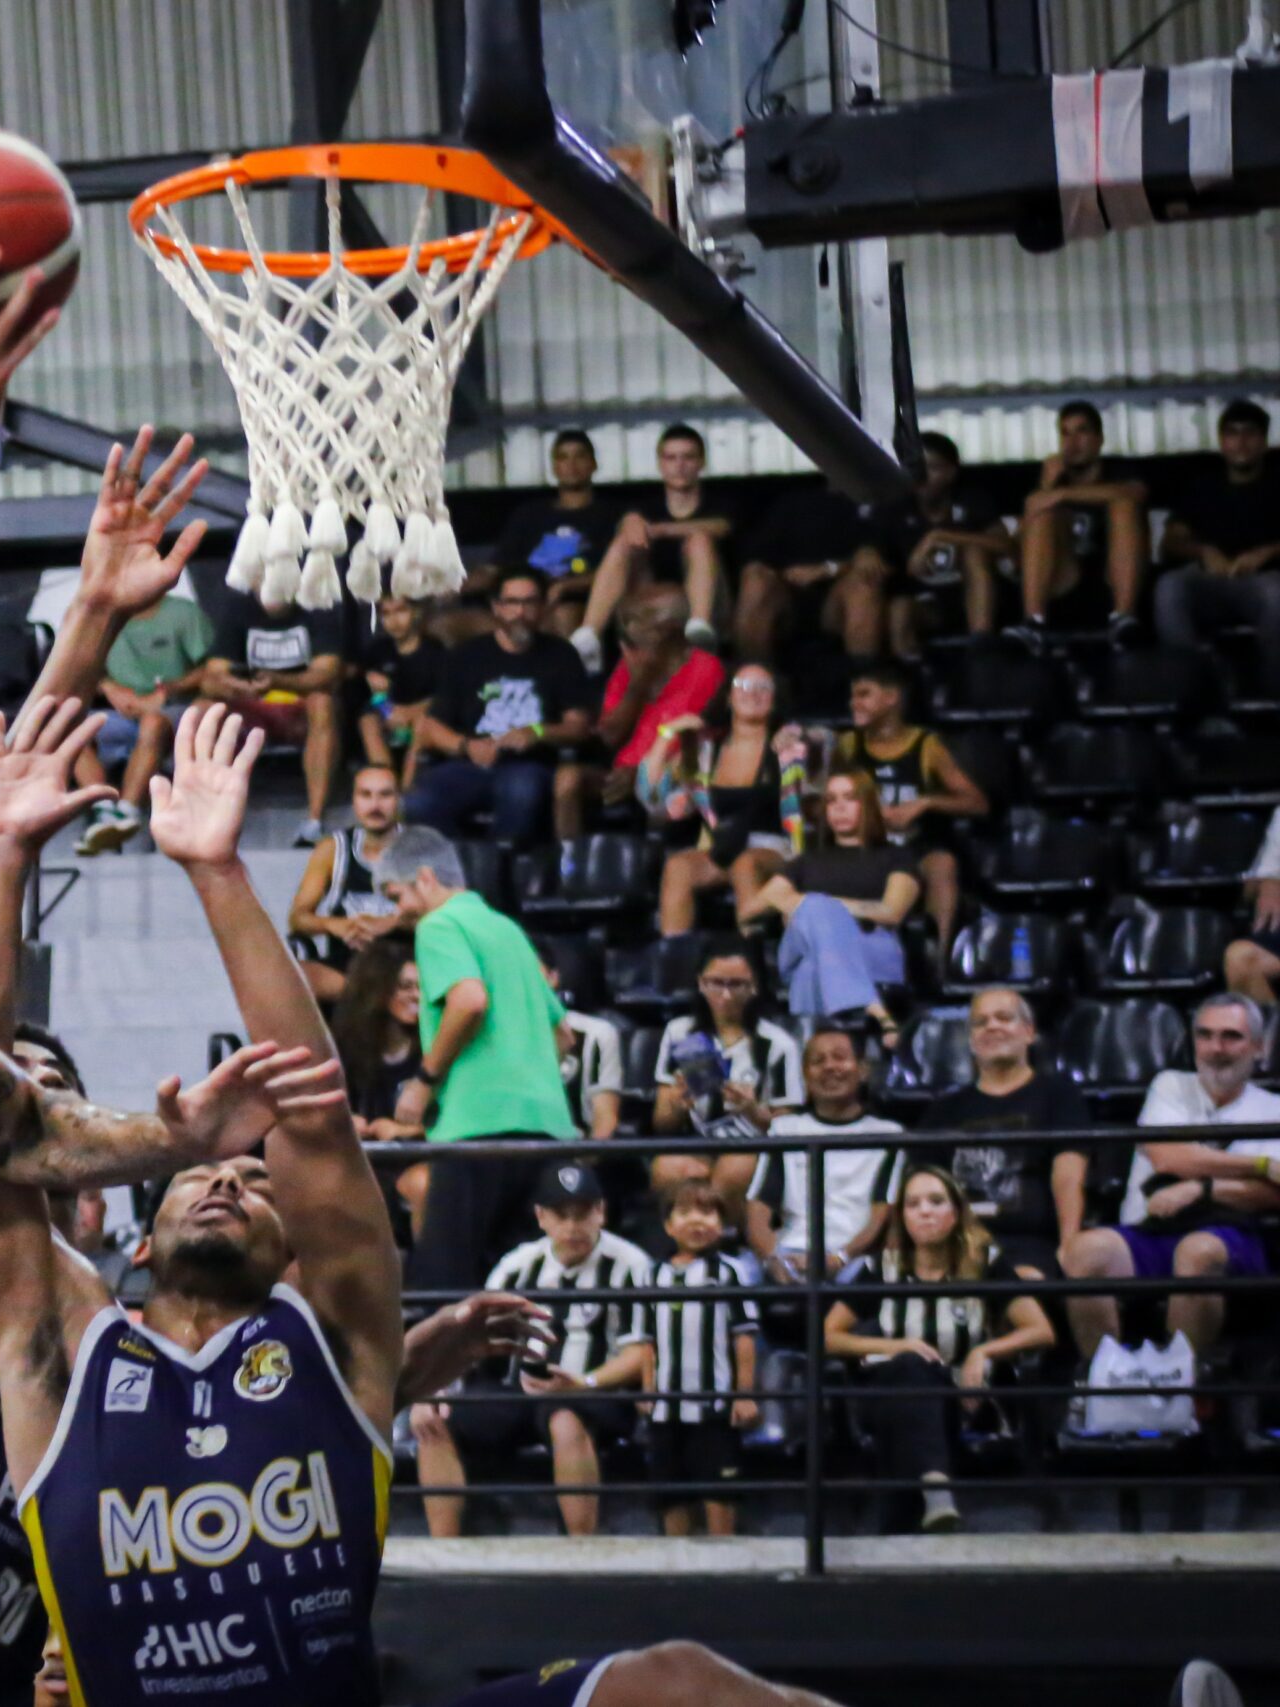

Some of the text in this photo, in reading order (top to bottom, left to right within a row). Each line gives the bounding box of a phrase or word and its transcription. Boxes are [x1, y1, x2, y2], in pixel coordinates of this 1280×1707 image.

[99, 1451, 340, 1577] MOGI
[110, 1543, 347, 1606] BASQUETE
[290, 1588, 352, 1617] necton
[164, 1613, 257, 1667] HIC
